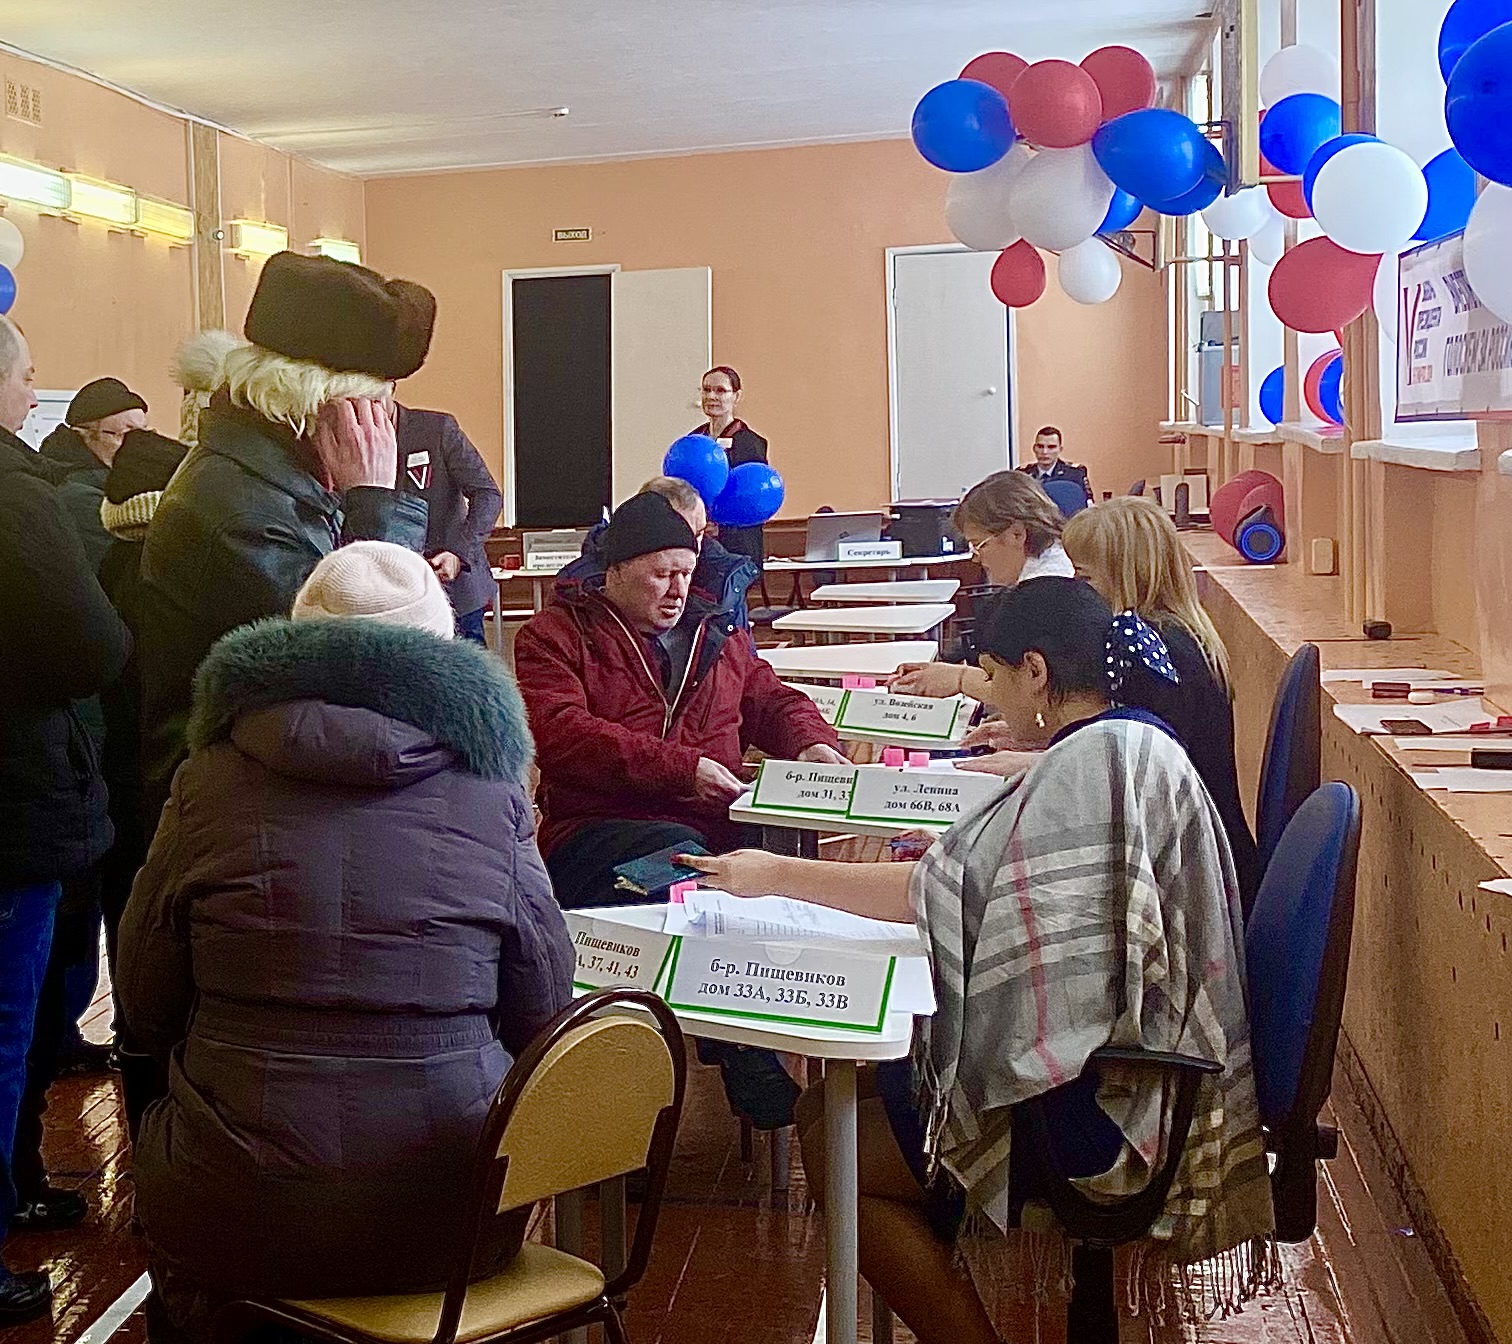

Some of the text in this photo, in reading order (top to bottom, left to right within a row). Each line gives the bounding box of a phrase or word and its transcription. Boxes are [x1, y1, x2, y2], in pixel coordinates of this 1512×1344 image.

[785, 770, 805, 783] б-р.
[797, 790, 819, 798] дом
[821, 789, 837, 800] 31,
[892, 783, 959, 795] ул. Ленина
[884, 800, 960, 813] дом 66В, 68А
[575, 931, 641, 957] Пищевиков
[588, 956, 603, 972] 37,
[606, 961, 621, 976] 41,
[625, 965, 639, 978] 43
[710, 958, 846, 987] б-р. Пищевиков
[697, 982, 849, 1010] дом 33А, 33Б, 33В
